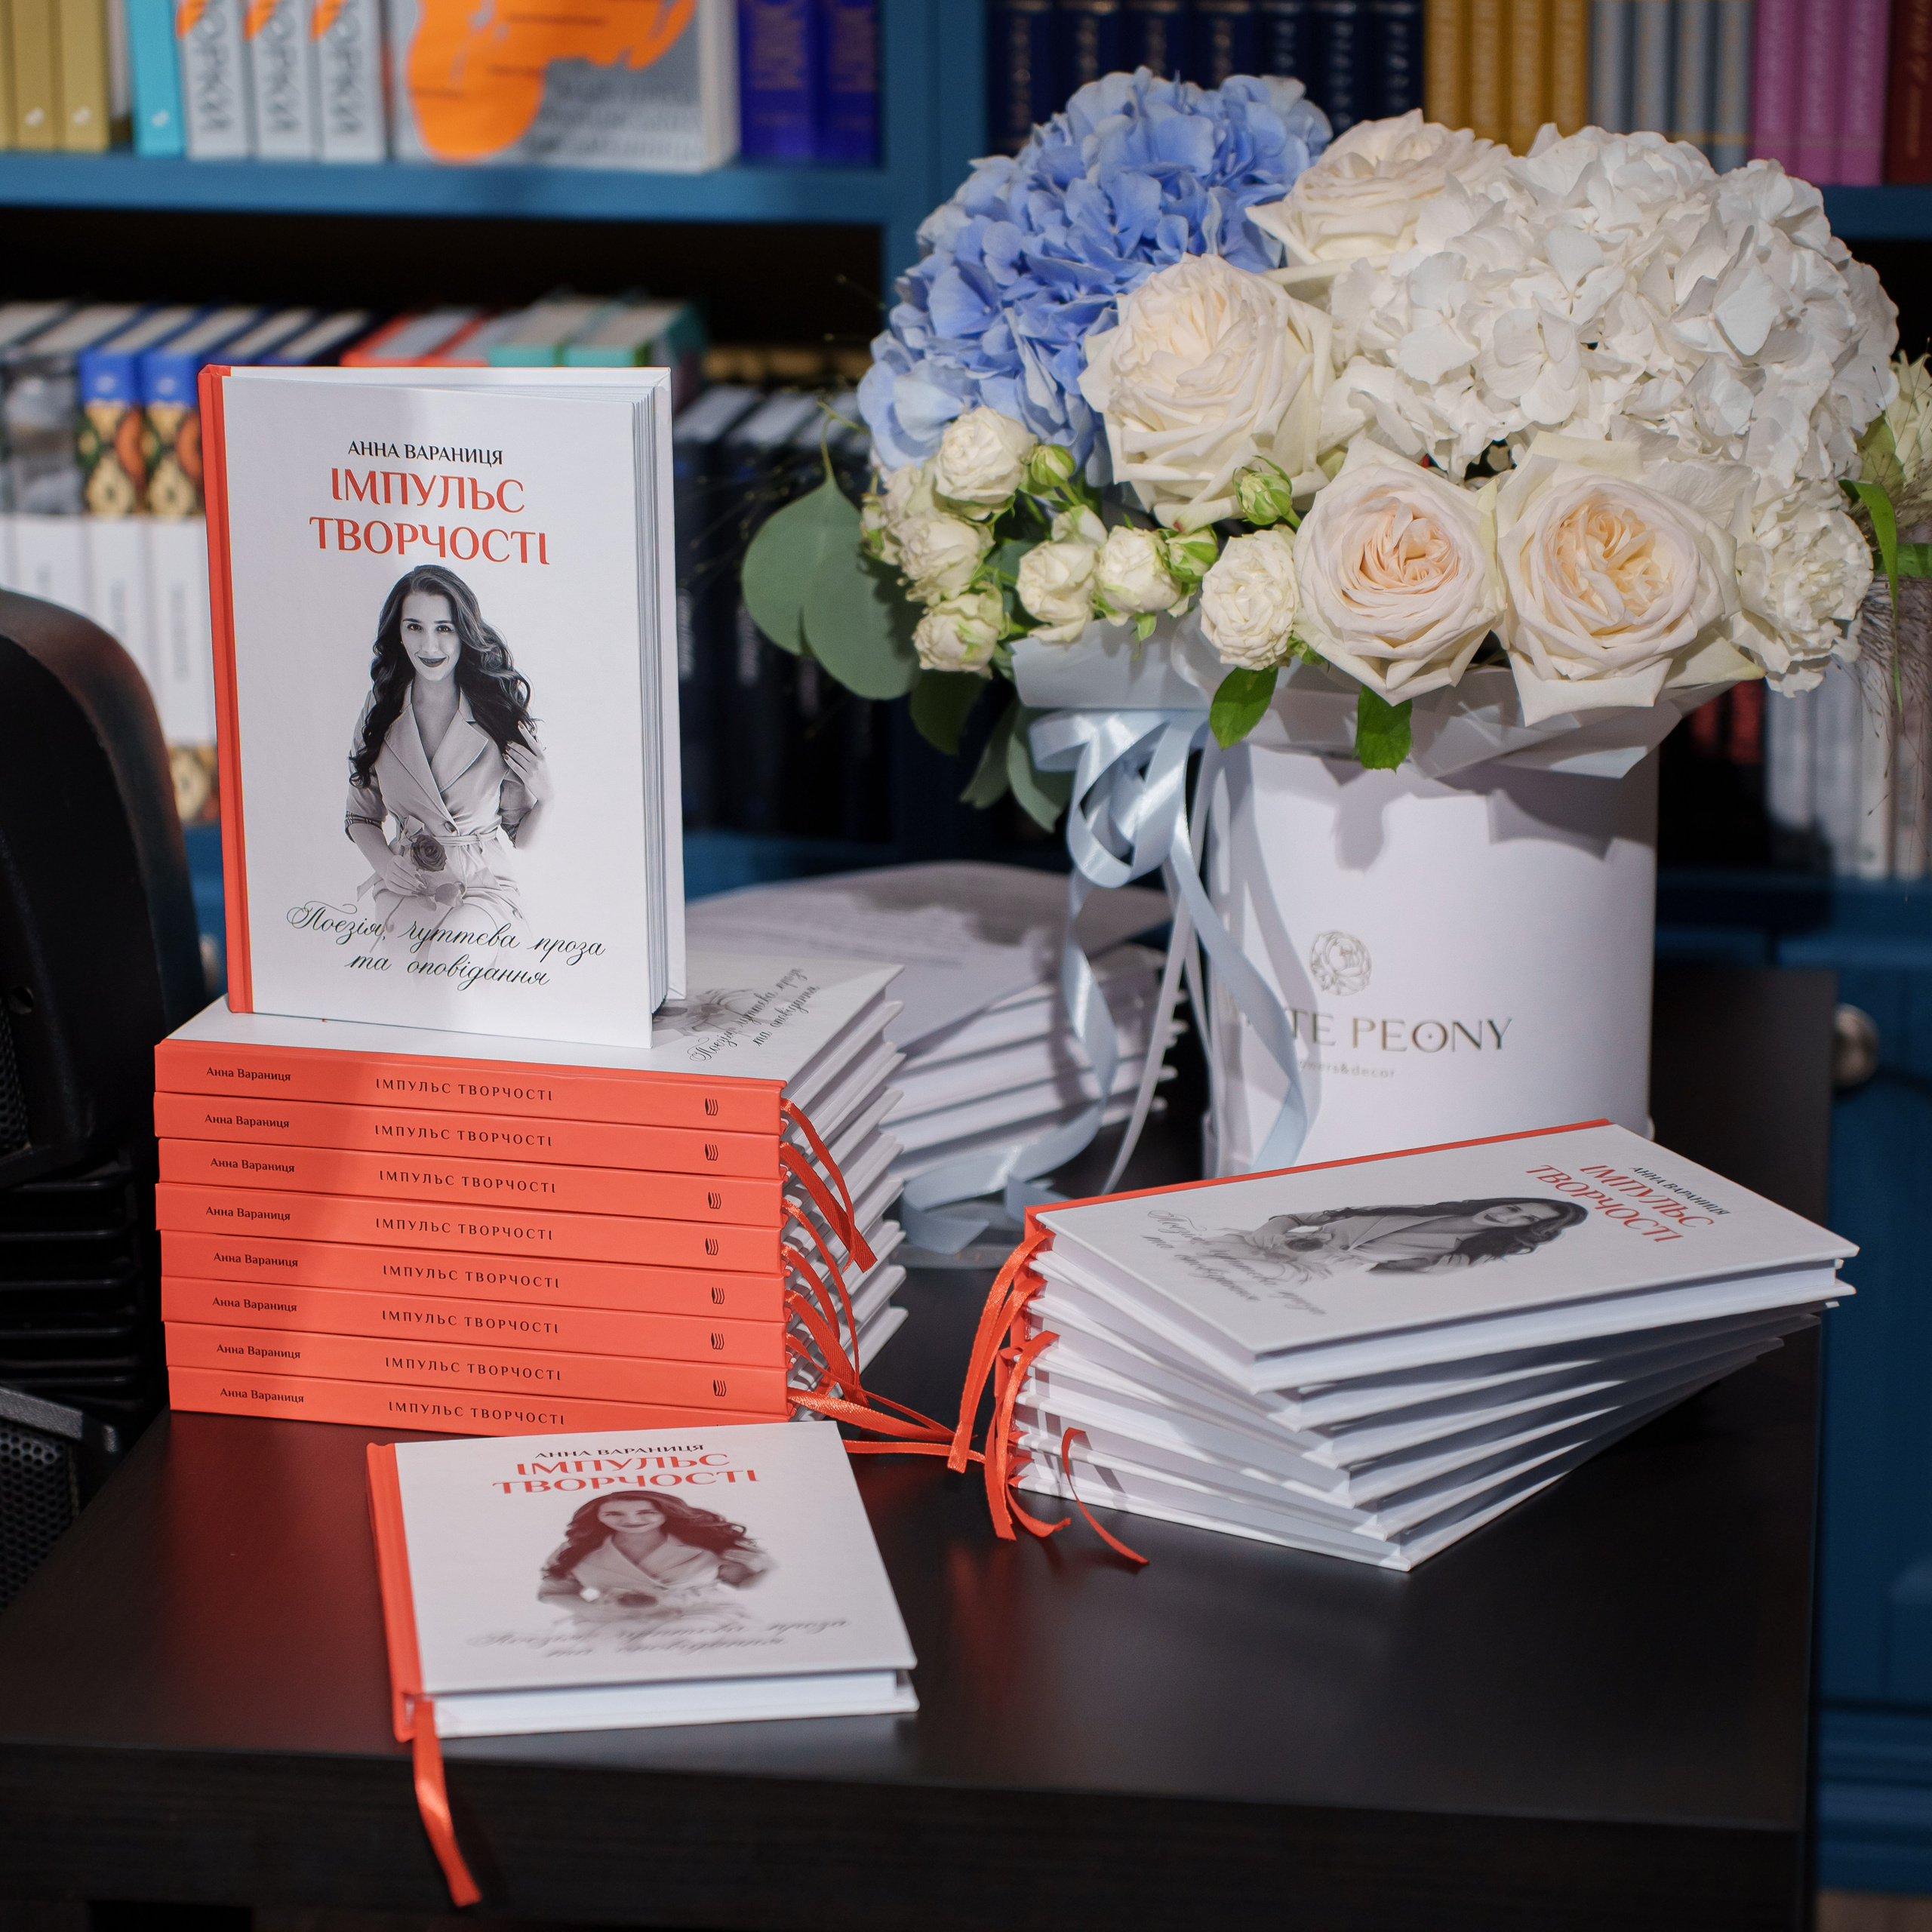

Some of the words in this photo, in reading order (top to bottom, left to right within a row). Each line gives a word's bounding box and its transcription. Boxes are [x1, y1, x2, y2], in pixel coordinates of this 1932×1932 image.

[348, 441, 400, 458] АННА
[404, 444, 503, 468] ВАРАНИЦЯ
[331, 467, 525, 513] ІМПУЛЬС
[309, 516, 551, 565] ТВОРЧОСТІ
[527, 935, 606, 965] проза
[344, 953, 392, 971] та
[407, 953, 551, 991] оповідання
[1284, 1006, 1337, 1046] TE
[1352, 1017, 1512, 1053] PEONY
[206, 1066, 234, 1078] Анна
[236, 1068, 291, 1083] Вараниця
[376, 1078, 451, 1094] ІМПУЛЬС
[457, 1084, 552, 1101] ТВОРЧОСТІ
[205, 1114, 233, 1124] Анна
[235, 1115, 290, 1130] Вараниця
[374, 1124, 450, 1140] ІМПУЛЬС
[457, 1130, 552, 1147] ТВОРЧОСТІ
[210, 1158, 238, 1168] Анна
[241, 1159, 295, 1174] Вараниця
[380, 1170, 454, 1186] ІМПУЛЬС
[461, 1176, 555, 1194] ТВОРЧОСТІ
[1629, 1167, 1666, 1184] АННА
[1525, 1164, 1684, 1243] ТВОРЧОСТІ
[1579, 1164, 1715, 1228] ІМПУЛЬС
[205, 1206, 234, 1217] Анна
[236, 1208, 291, 1222] Вараниця
[376, 1217, 451, 1233] ІМПУЛЬС
[457, 1223, 552, 1241] ТВОРЧОСТІ
[213, 1252, 242, 1263] Анна
[244, 1254, 298, 1269] Вараниця
[383, 1265, 458, 1281] ІМПУЛЬС
[464, 1271, 559, 1288] ТВОРЧОСТІ
[212, 1297, 241, 1308] Анна
[243, 1298, 297, 1313] Вараниця
[382, 1309, 457, 1326] ІМПУЛЬС
[463, 1316, 558, 1334] ТВОРЧОСТІ
[216, 1343, 245, 1355] Анна
[247, 1345, 301, 1360] Вараниця
[385, 1357, 460, 1373] ІМПУЛЬС
[466, 1363, 561, 1381] ТВОРЧОСТІ
[220, 1387, 248, 1398] Анна
[250, 1389, 304, 1404] Вараниця
[389, 1401, 463, 1417] ІМПУЛЬС
[470, 1407, 565, 1426] ТВОРЧОСТІ
[516, 1454, 730, 1476] ІМПУЛЬС
[535, 1450, 592, 1459] АННА
[597, 1444, 704, 1457] ВАРАНИЦЯ
[492, 1469, 760, 1494] ТВОРЧОСТІ
